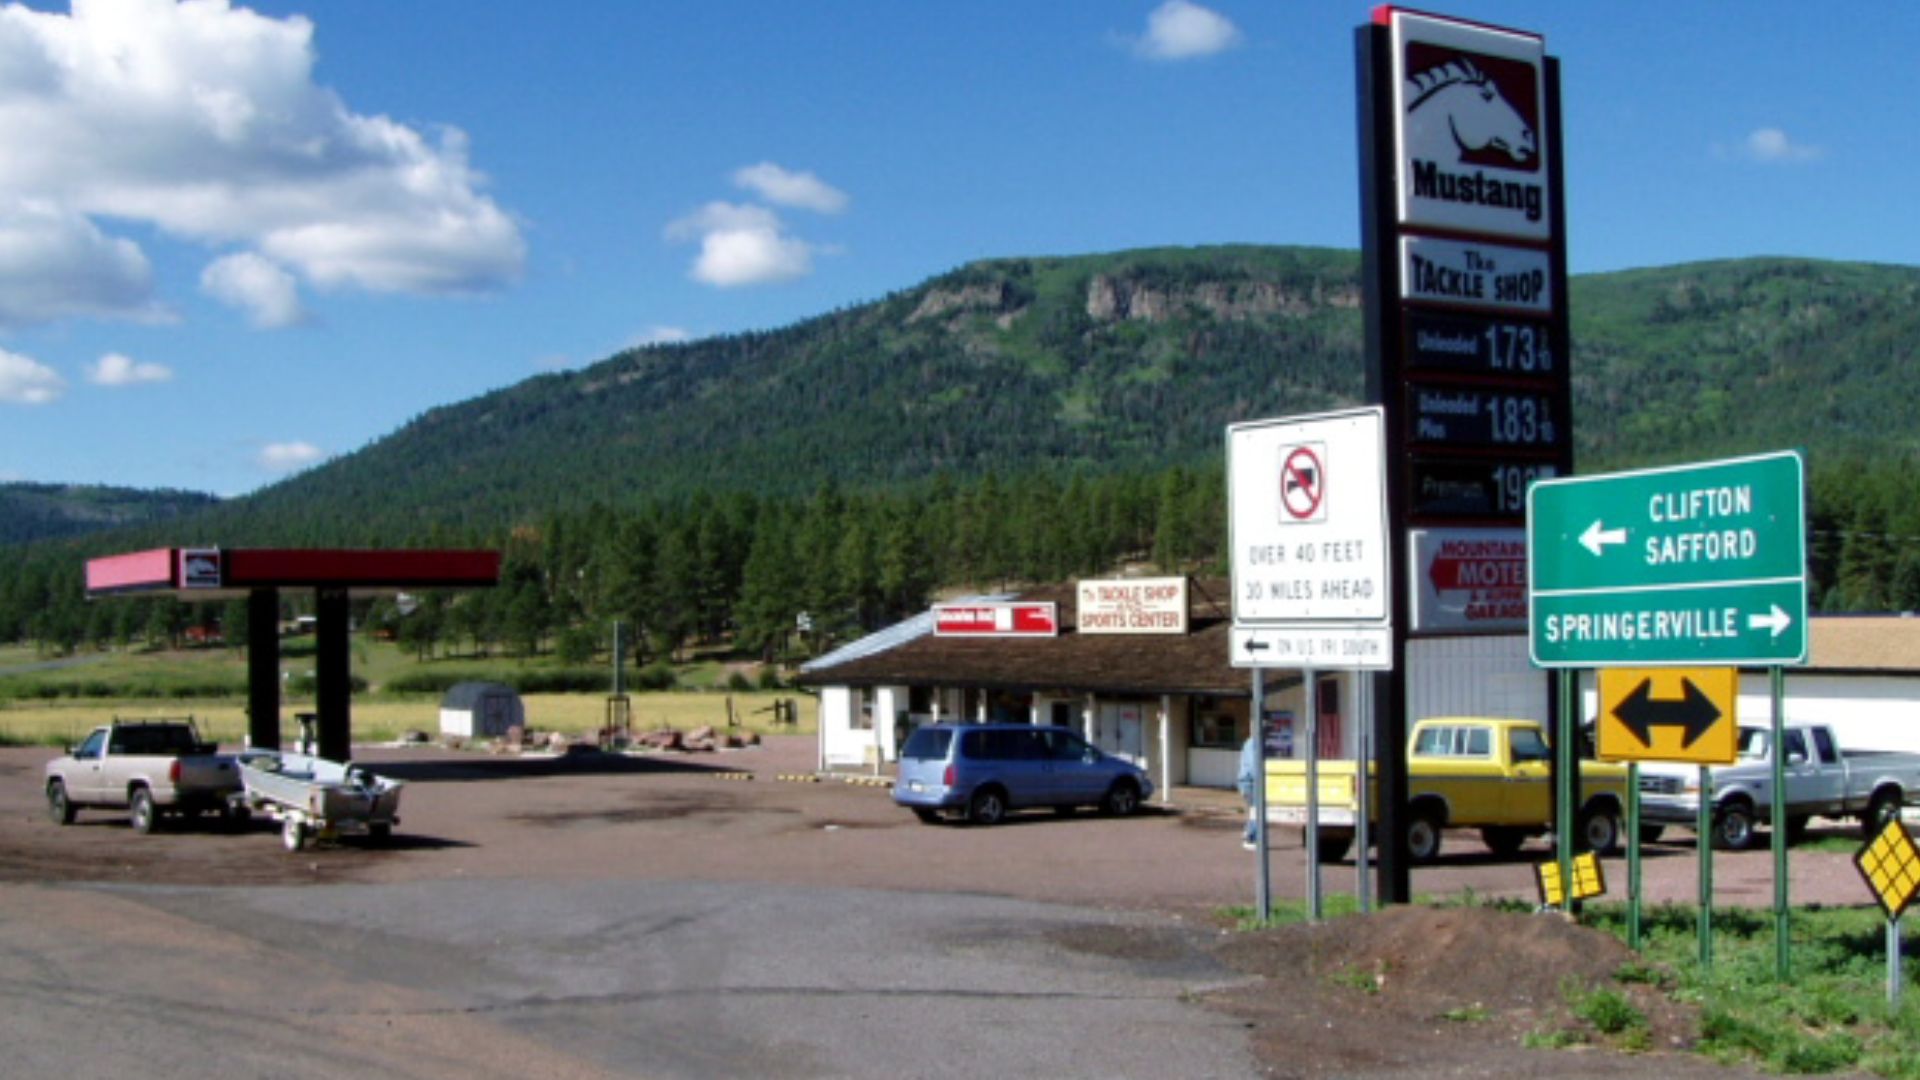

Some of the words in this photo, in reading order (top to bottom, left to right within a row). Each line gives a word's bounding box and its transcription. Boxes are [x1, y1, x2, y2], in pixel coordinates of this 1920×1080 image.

[1411, 158, 1542, 222] Mustang
[1464, 251, 1495, 273] The
[1411, 254, 1485, 299] TACKLE
[1494, 269, 1543, 303] SHOP
[1649, 485, 1751, 523] CLIFTON
[1249, 544, 1286, 566] OVER
[1296, 542, 1315, 563] 40
[1321, 539, 1363, 563] FEET
[1646, 529, 1756, 565] SAFFORD
[1459, 560, 1526, 585] MOTE
[1097, 586, 1141, 602] TACKLE
[1143, 585, 1179, 601] SHOP
[1270, 579, 1313, 600] MILES
[1320, 577, 1375, 600] AHEAD
[1081, 613, 1126, 628] SPORTS
[1129, 611, 1179, 628] CENTER
[1545, 607, 1738, 641] SPRINGERVILLE
[1342, 637, 1379, 655] SOUTH
